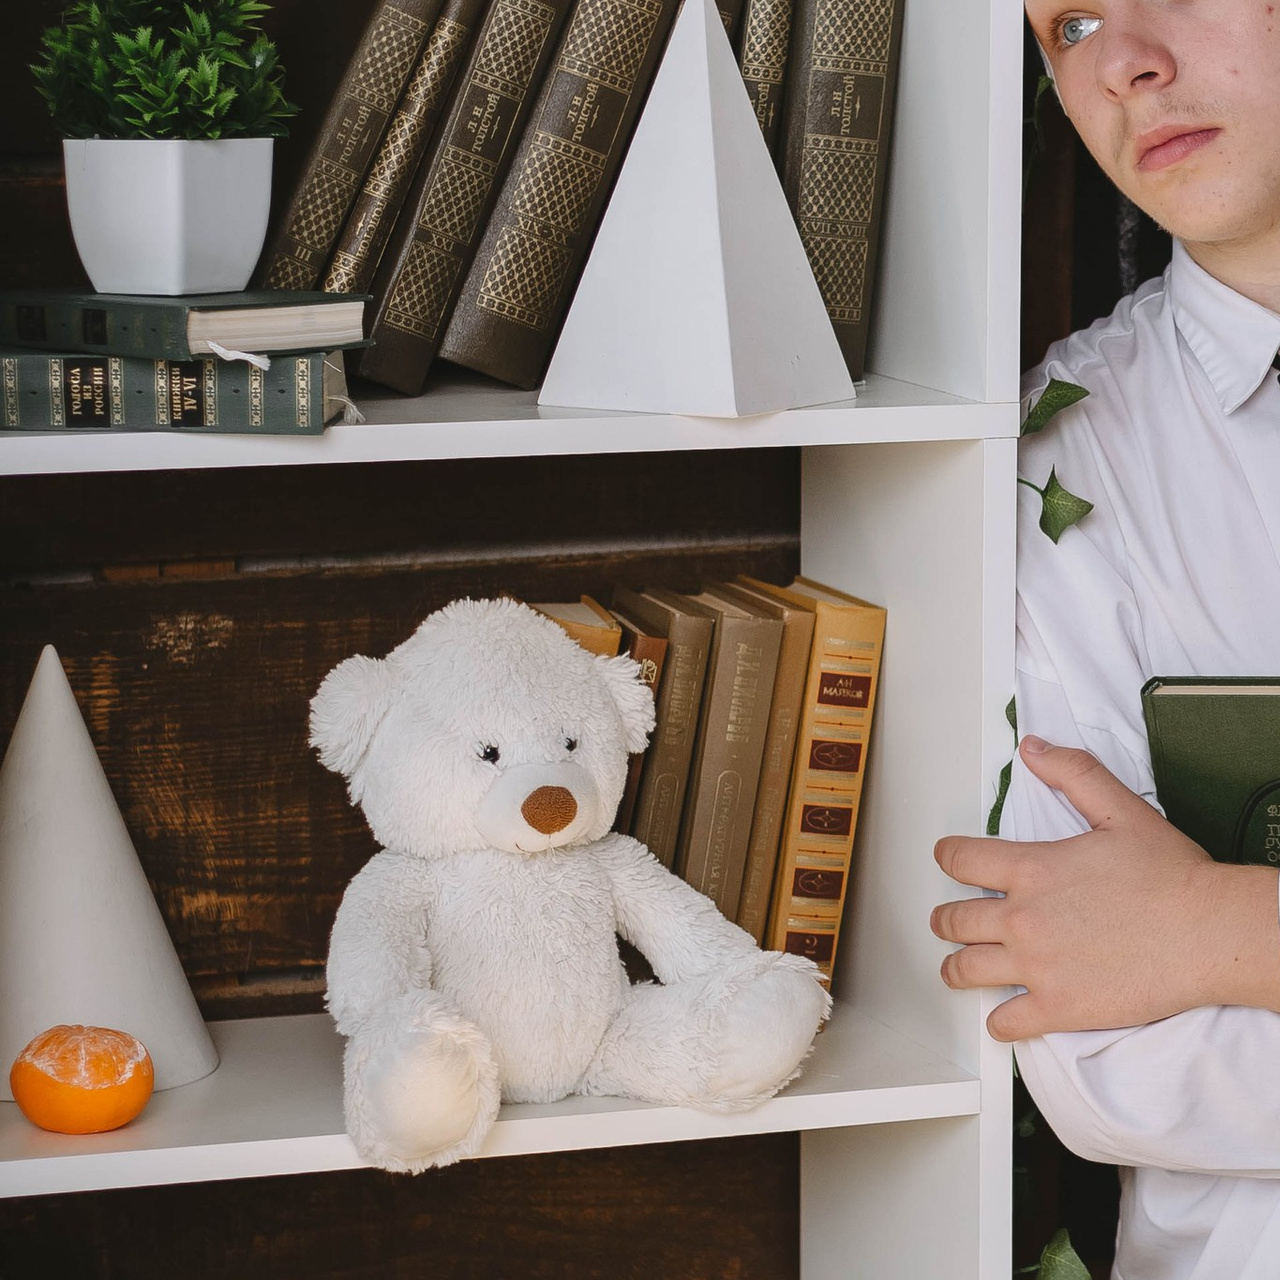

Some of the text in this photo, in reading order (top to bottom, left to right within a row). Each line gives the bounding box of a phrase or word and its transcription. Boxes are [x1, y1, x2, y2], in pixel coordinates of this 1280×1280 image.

[471, 92, 501, 153] ТОЛСТОЙ
[571, 80, 599, 143] ТОЛСТОЙ
[840, 74, 855, 136] ТОЛСТОЙ
[338, 105, 371, 165] ТОЛСТОЙ
[294, 245, 313, 262] III
[431, 233, 454, 252] XXI
[70, 367, 82, 415] ГОЛОСА
[82, 384, 92, 400] ИЗ
[93, 367, 105, 415] РОССИИ
[171, 367, 182, 420] КНИЖКИ
